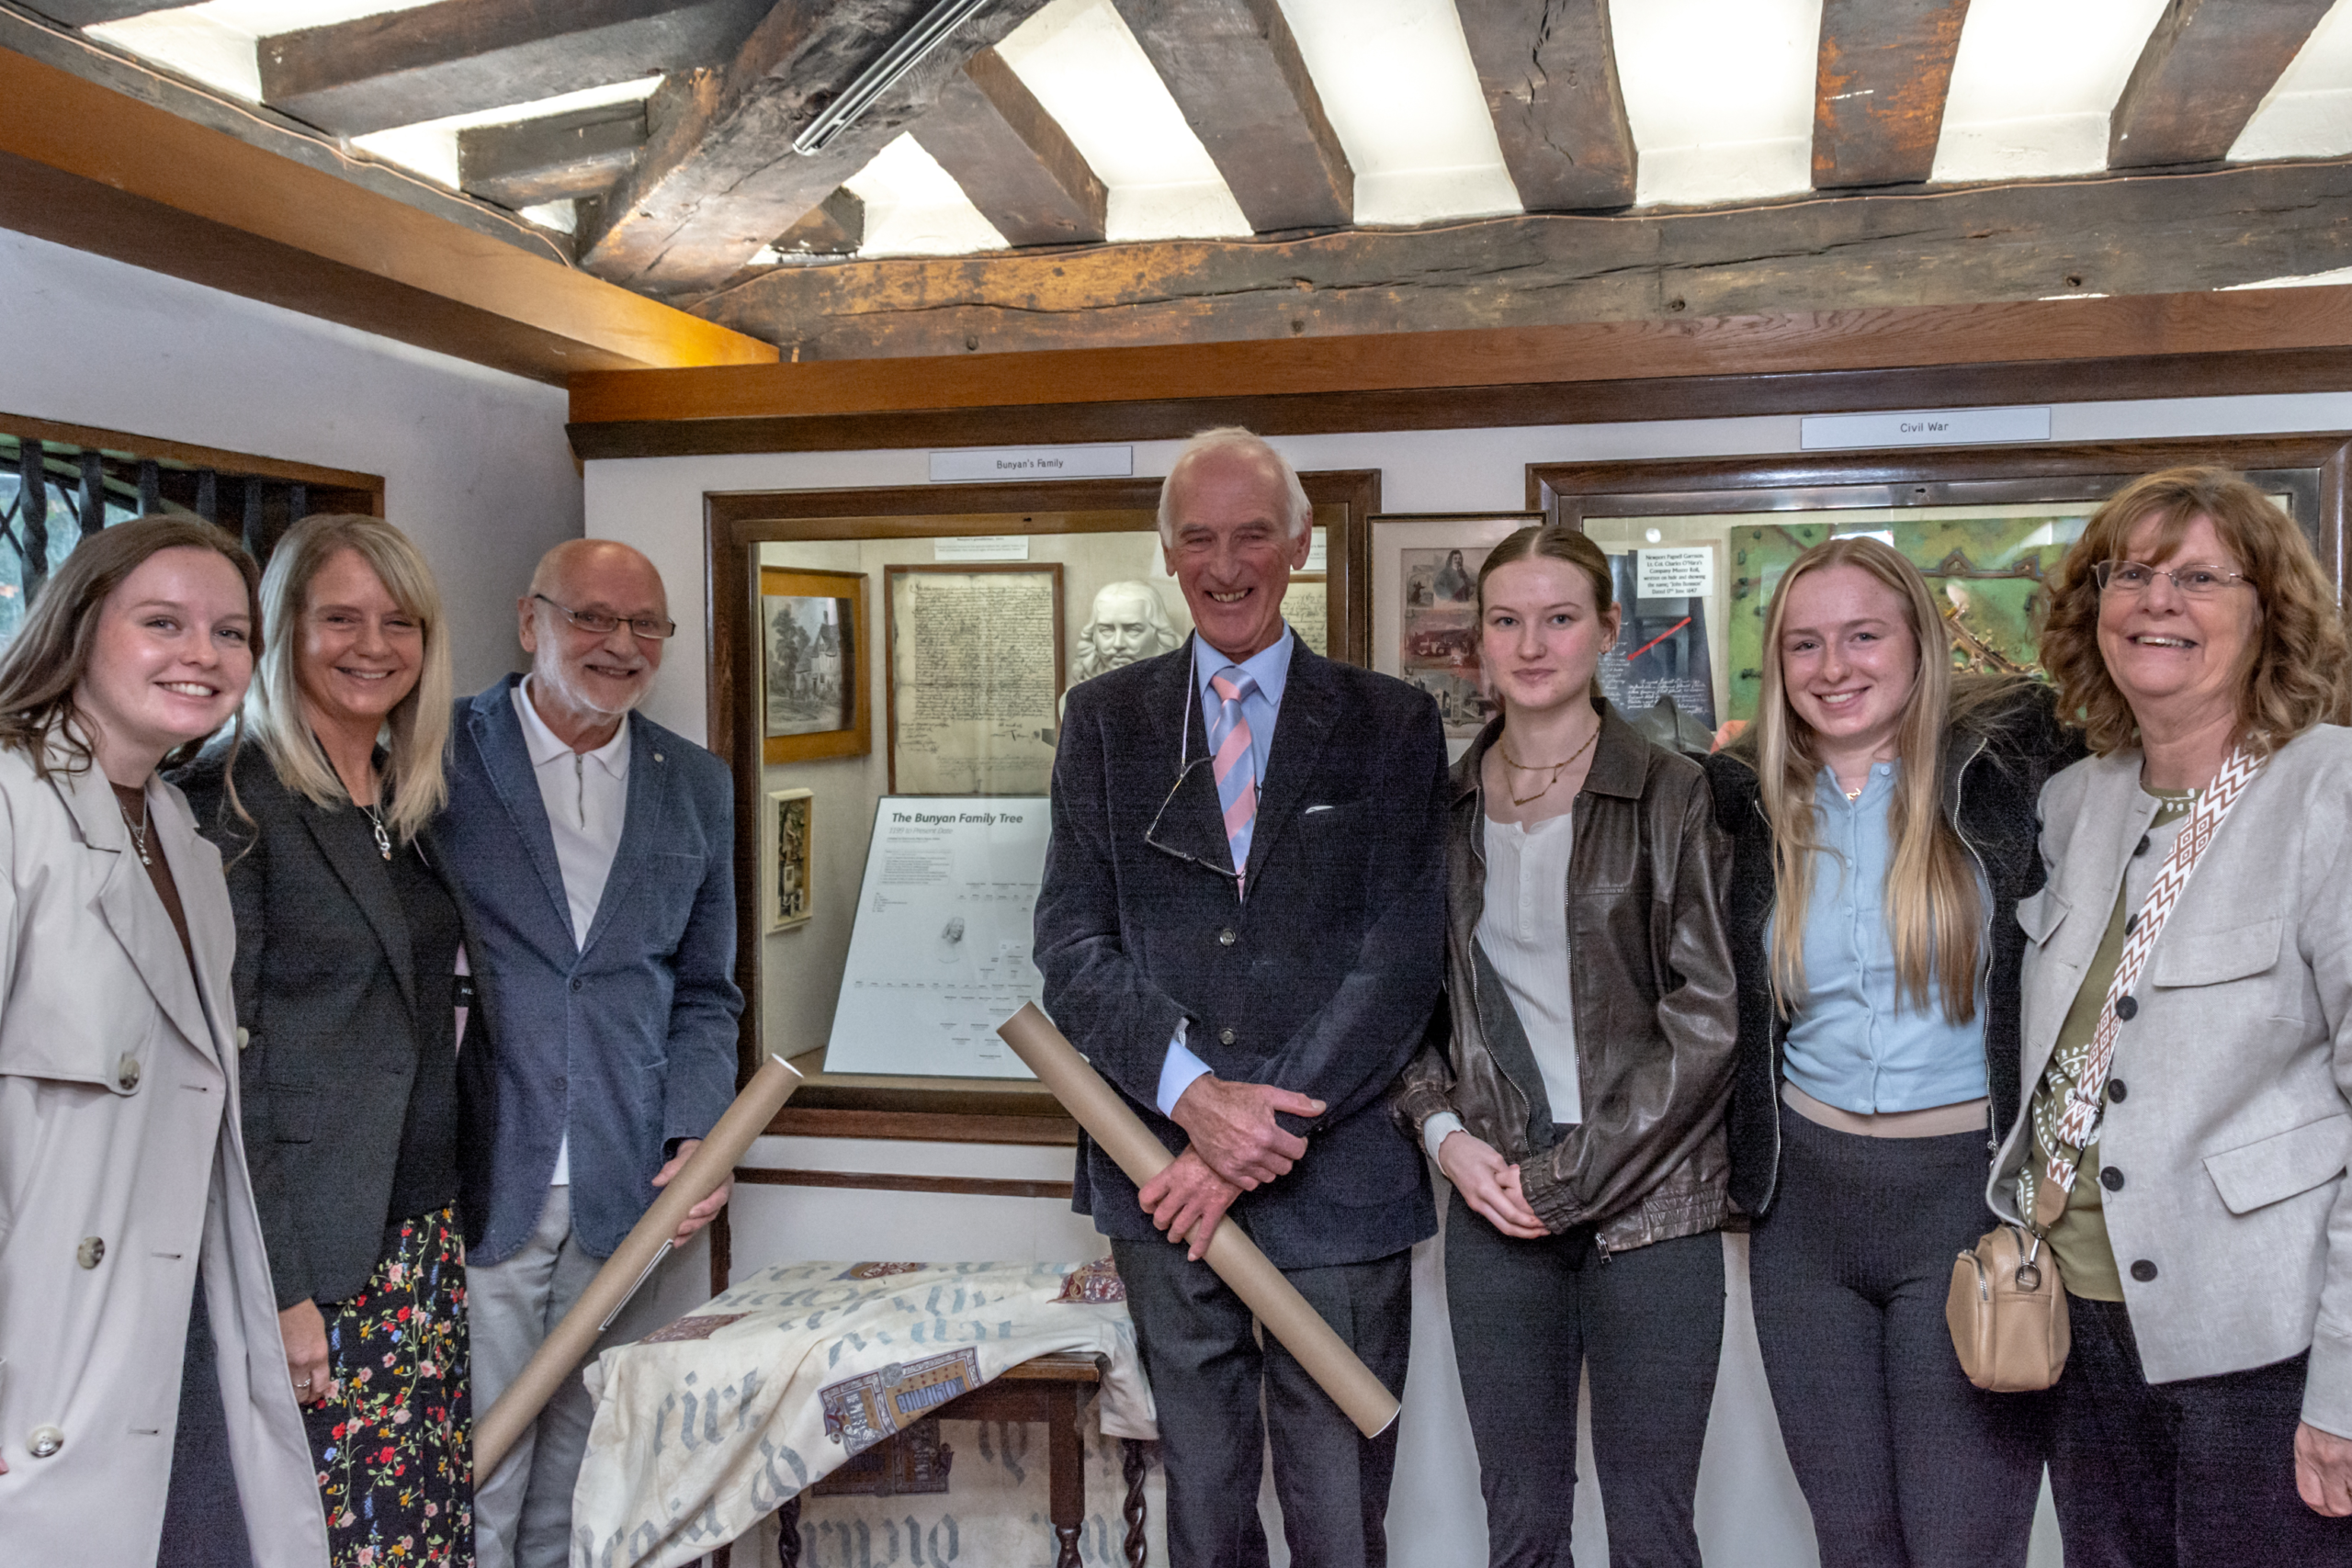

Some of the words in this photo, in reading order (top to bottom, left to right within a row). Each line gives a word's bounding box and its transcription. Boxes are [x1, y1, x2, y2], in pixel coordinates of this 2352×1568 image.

[1900, 423, 1924, 433] Civil
[1928, 422, 1950, 432] War
[996, 459, 1035, 469] Bunyan's
[1037, 458, 1064, 468] Family
[892, 813, 912, 823] The
[914, 813, 956, 826] Bunyan
[958, 813, 997, 826] Family
[1000, 813, 1023, 823] Tree
